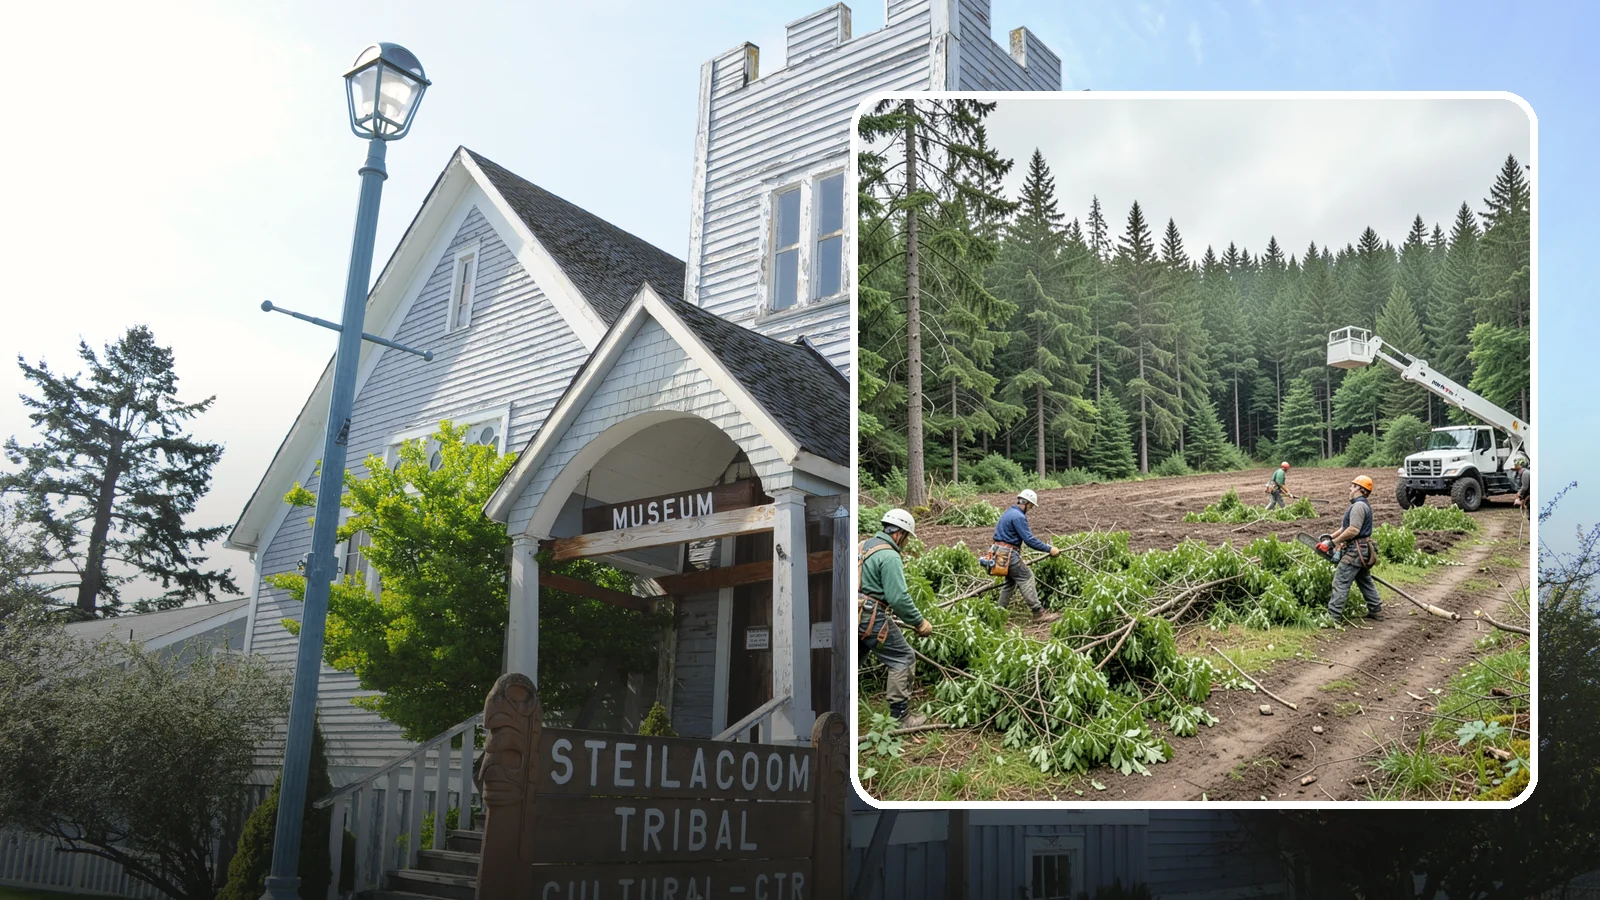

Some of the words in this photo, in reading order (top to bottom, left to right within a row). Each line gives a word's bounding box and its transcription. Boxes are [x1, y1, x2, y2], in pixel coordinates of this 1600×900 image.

[612, 491, 713, 530] MUSEUM
[551, 738, 809, 792] STEILACOOM
[615, 807, 757, 851] TRIBAL
